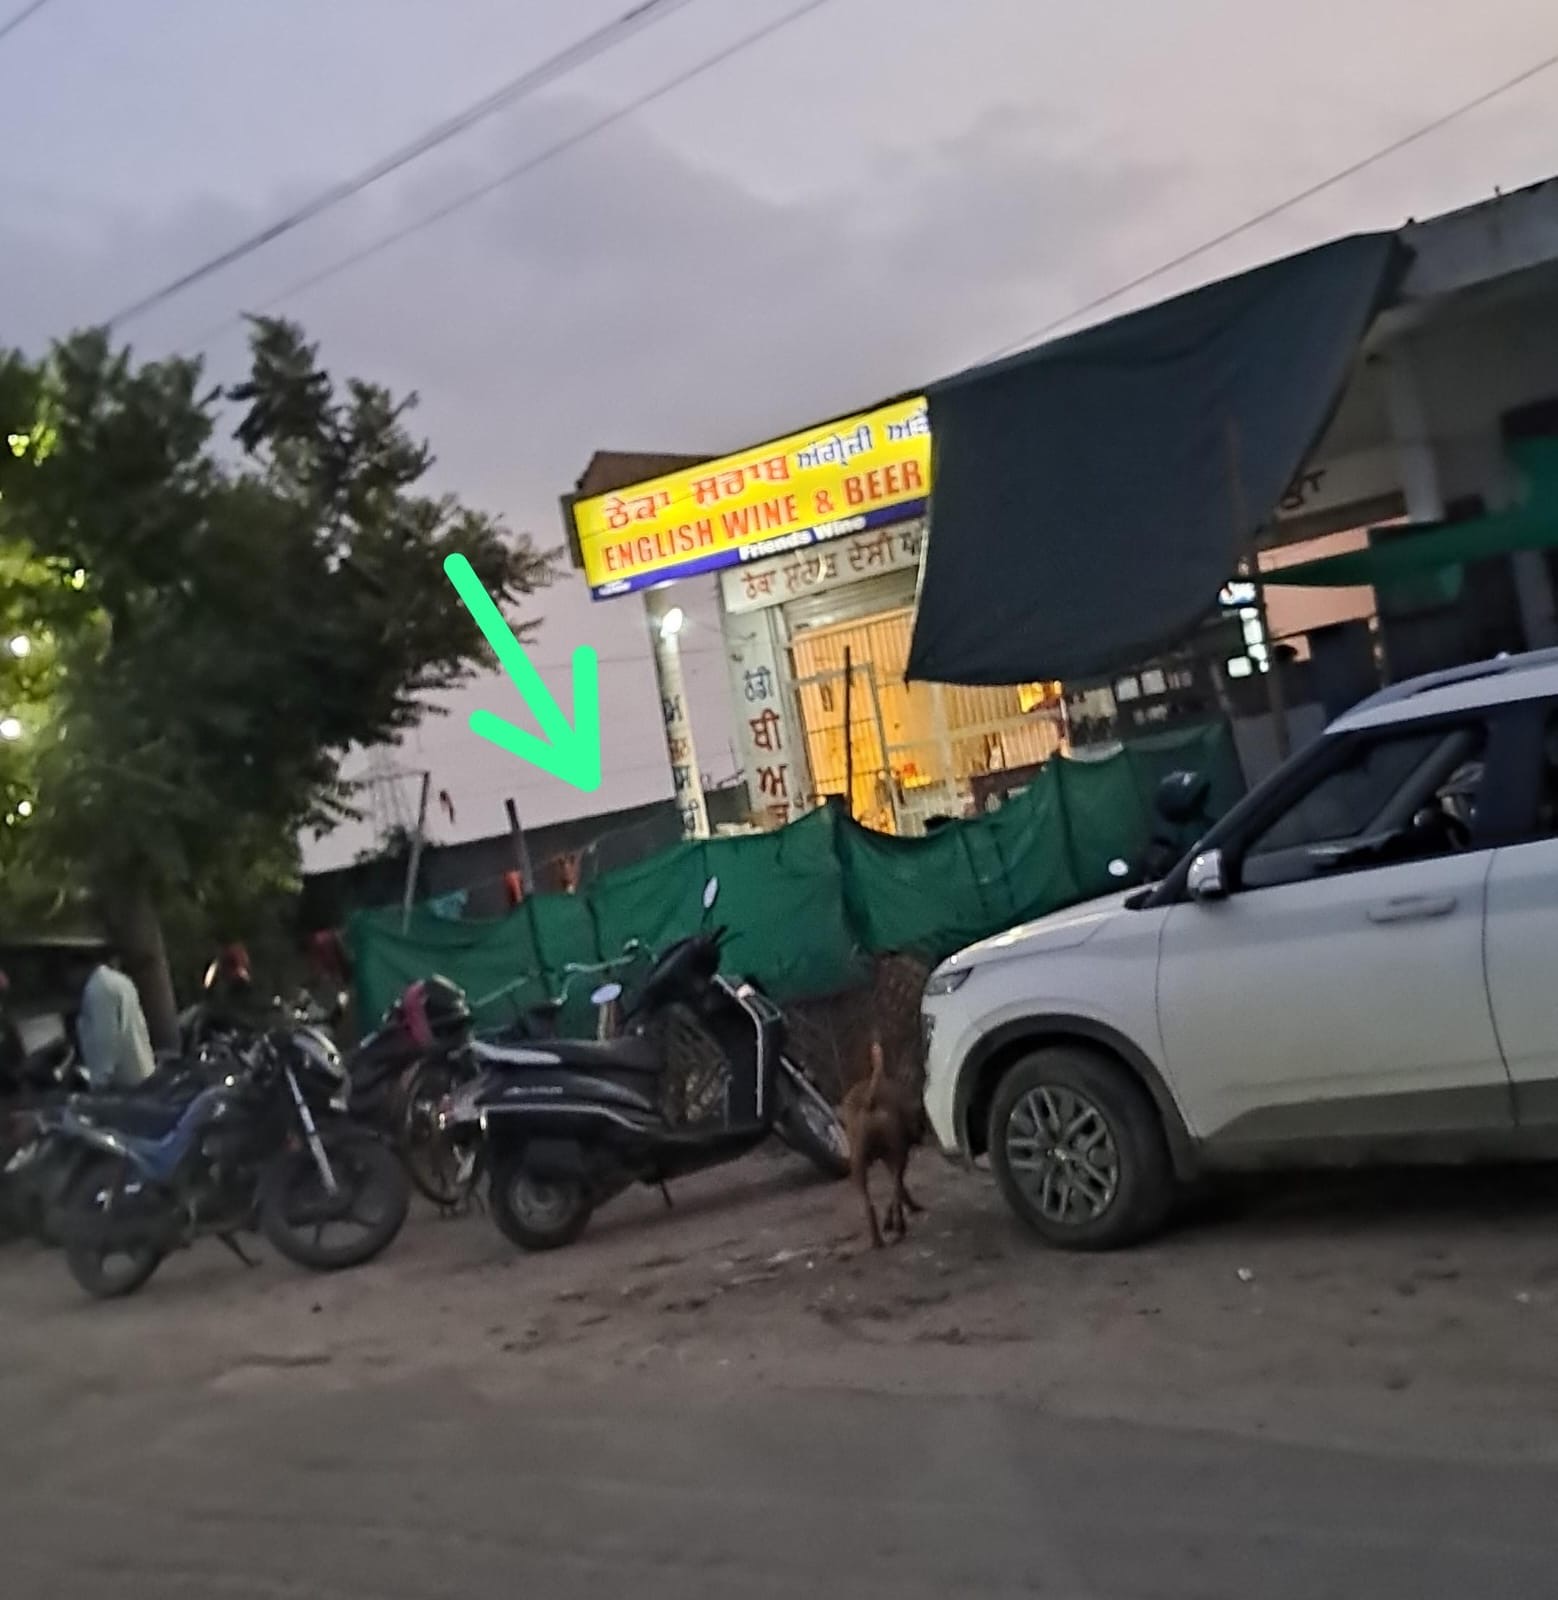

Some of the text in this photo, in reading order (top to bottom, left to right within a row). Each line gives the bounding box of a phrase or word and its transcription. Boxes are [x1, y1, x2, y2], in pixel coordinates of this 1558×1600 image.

[604, 460, 923, 572] ENGLISH WINE & BEER
